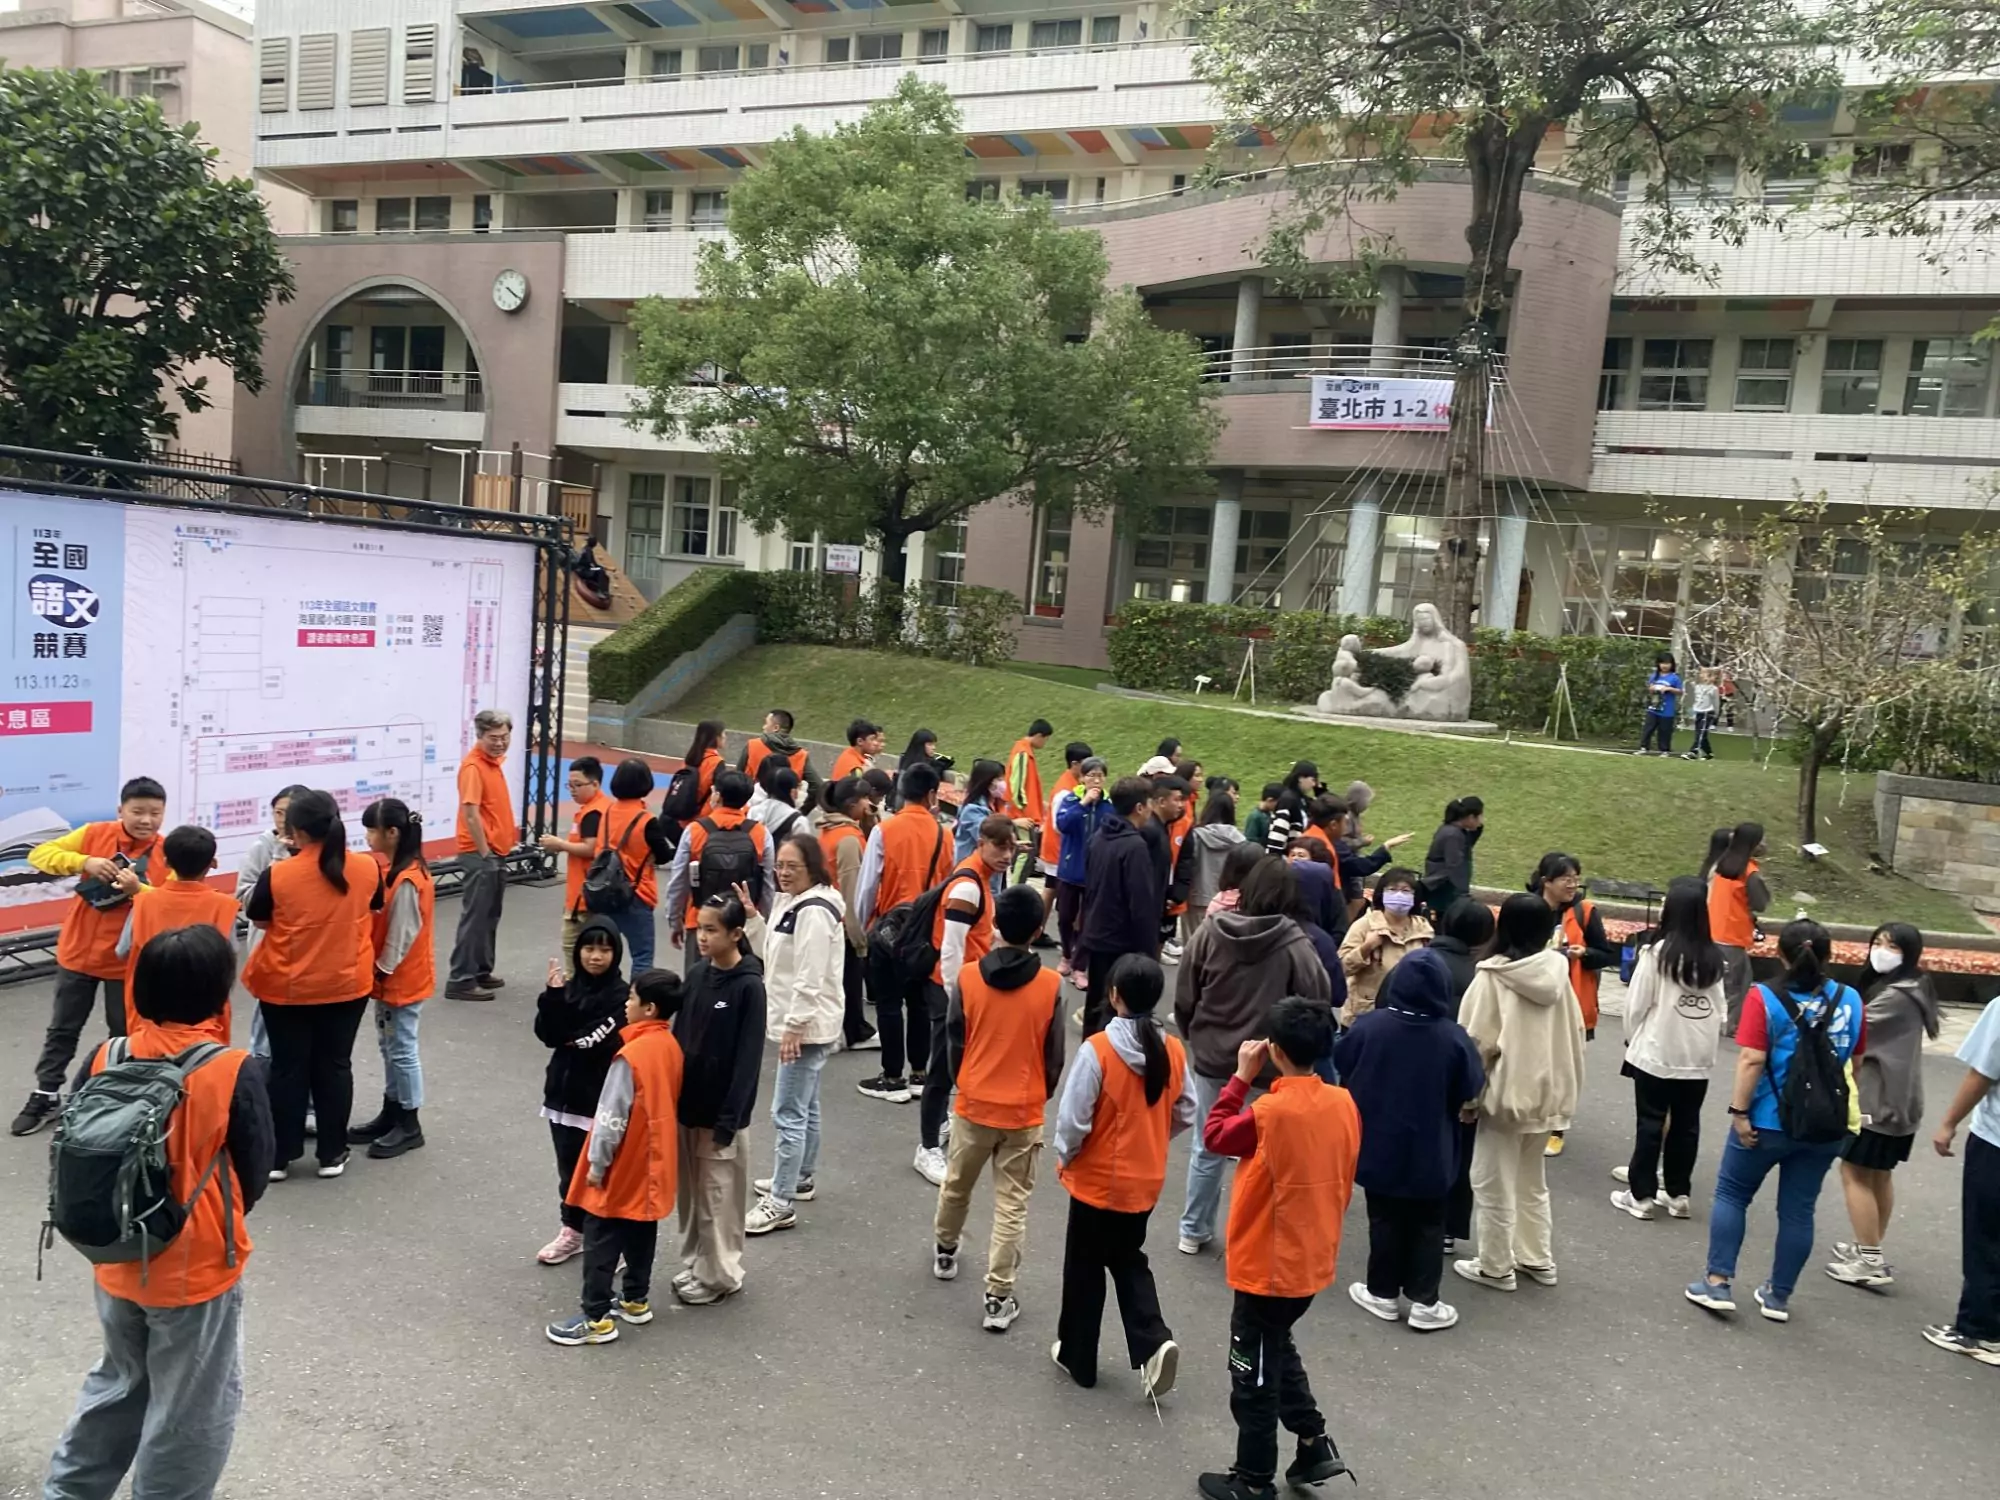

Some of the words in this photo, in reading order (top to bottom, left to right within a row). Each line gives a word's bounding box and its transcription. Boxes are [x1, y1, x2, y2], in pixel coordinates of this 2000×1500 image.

[1318, 397, 1386, 420] 臺北市
[1393, 399, 1428, 418] 1-2
[33, 541, 88, 570] 全國
[31, 581, 99, 623] 語文
[33, 632, 88, 659] 競賽
[14, 674, 79, 690] 113.11.23
